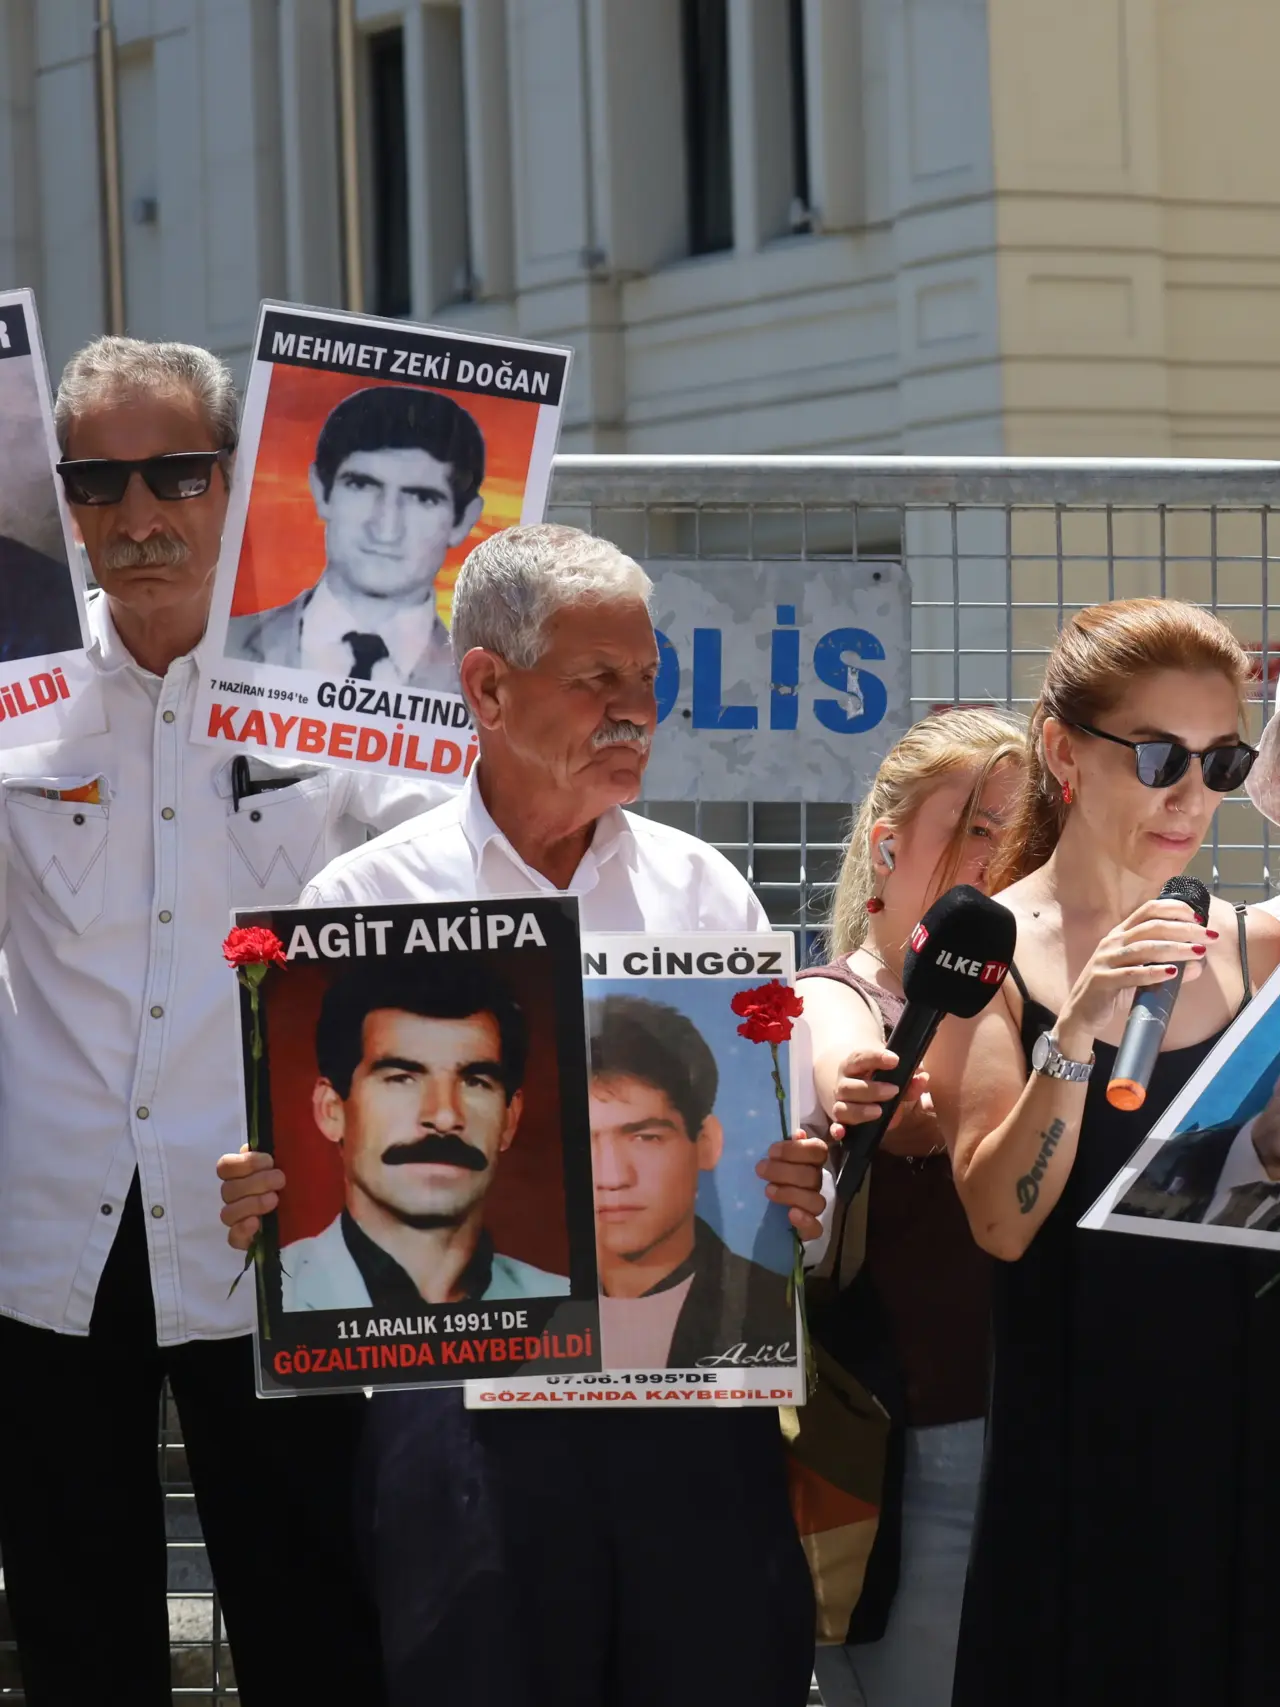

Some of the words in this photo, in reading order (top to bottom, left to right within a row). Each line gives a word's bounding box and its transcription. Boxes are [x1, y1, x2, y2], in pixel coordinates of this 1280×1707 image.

[272, 331, 387, 370] MEHMET
[390, 350, 451, 381] ZEKİ
[456, 360, 550, 396] DOĞAN
[654, 604, 888, 734] LİS
[210, 679, 216, 690] 7
[218, 680, 265, 698] HAZİRAN
[267, 688, 309, 704] 1994'te
[317, 678, 474, 730] GÖZALTIND
[207, 703, 478, 778] KAYBEDİLDİ
[286, 912, 394, 961] AGİT
[403, 907, 547, 954] AKİPA
[622, 946, 783, 976] CİNGÖZ
[984, 964, 1008, 982] TV
[273, 1341, 435, 1375] GÖZALTINDA
[442, 1327, 593, 1365] KAYBEDİLDİ
[337, 1320, 361, 1340] 11
[365, 1314, 438, 1338] ARALIK
[694, 1341, 798, 1368] Adil
